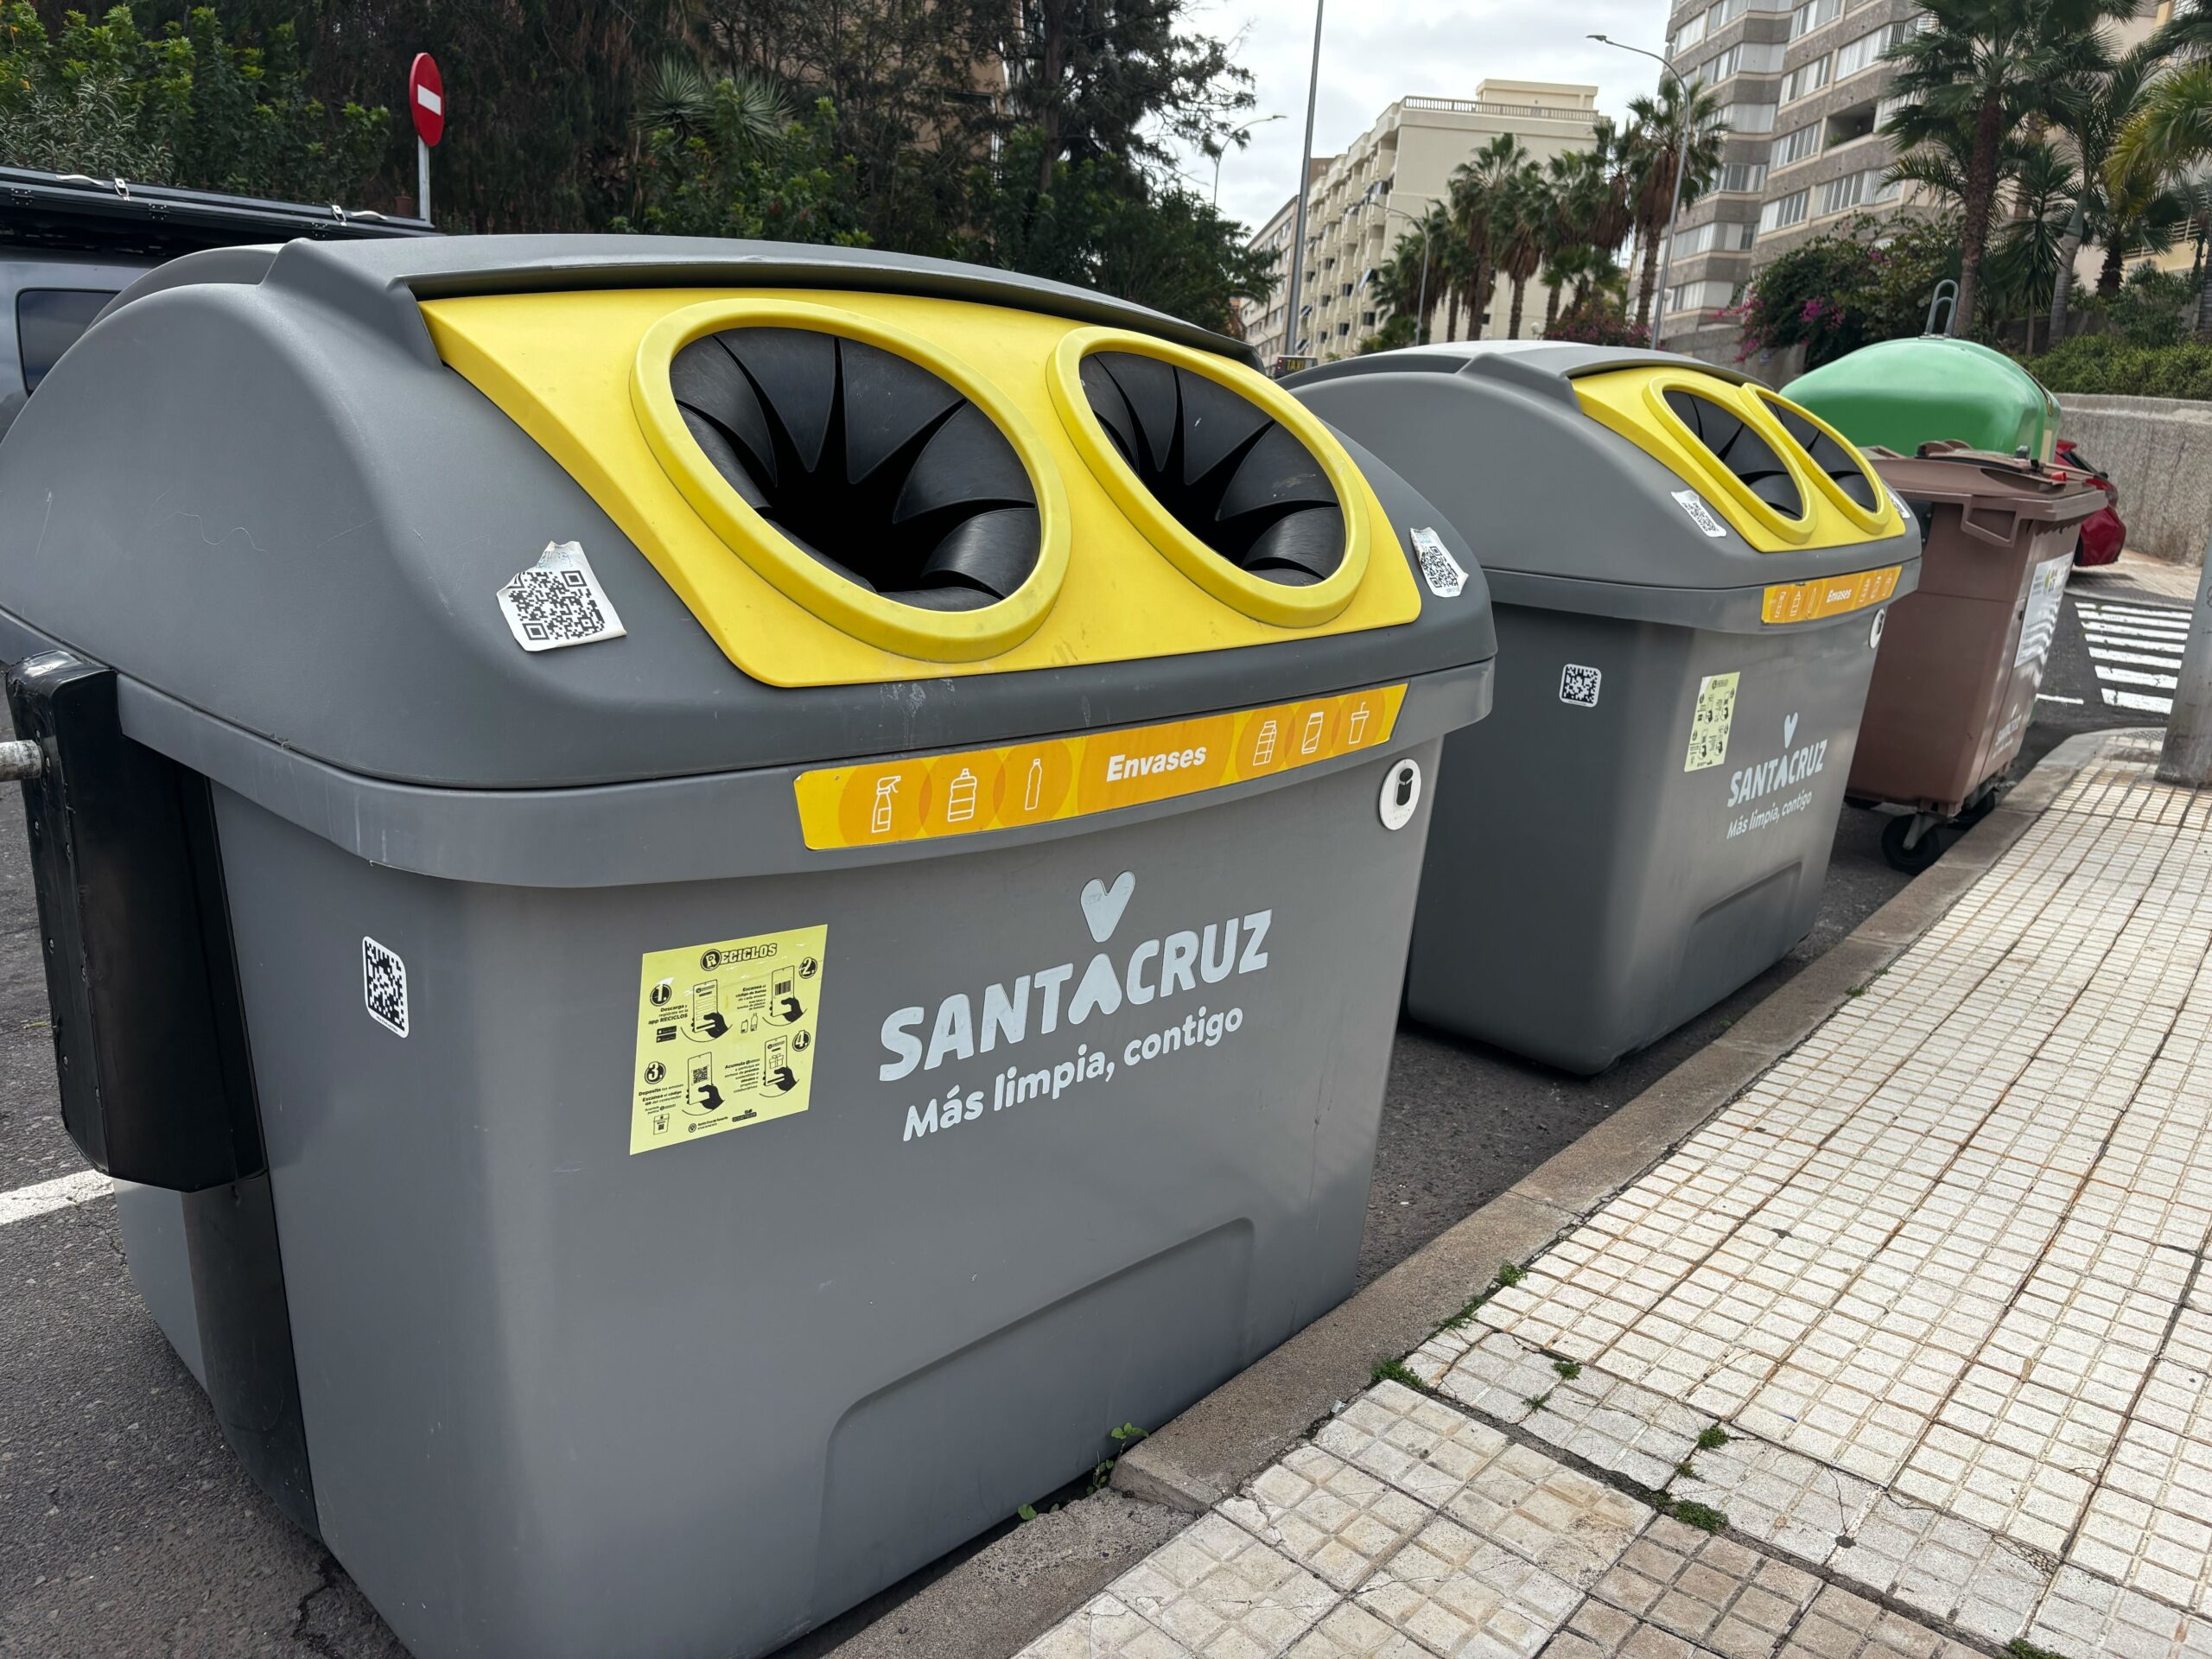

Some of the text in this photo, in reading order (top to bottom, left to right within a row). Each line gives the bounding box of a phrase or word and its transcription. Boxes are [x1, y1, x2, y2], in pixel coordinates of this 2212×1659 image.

[1826, 588, 1853, 603] Envases
[1106, 746, 1207, 783] Envases
[1726, 788, 1812, 840] Más limpia, contigo
[660, 1014, 689, 1022] RECICLOS
[725, 1061, 746, 1070] Acumula
[903, 1006, 1243, 1141] Más limpia, contigo
[639, 1088, 661, 1096] Deposita
